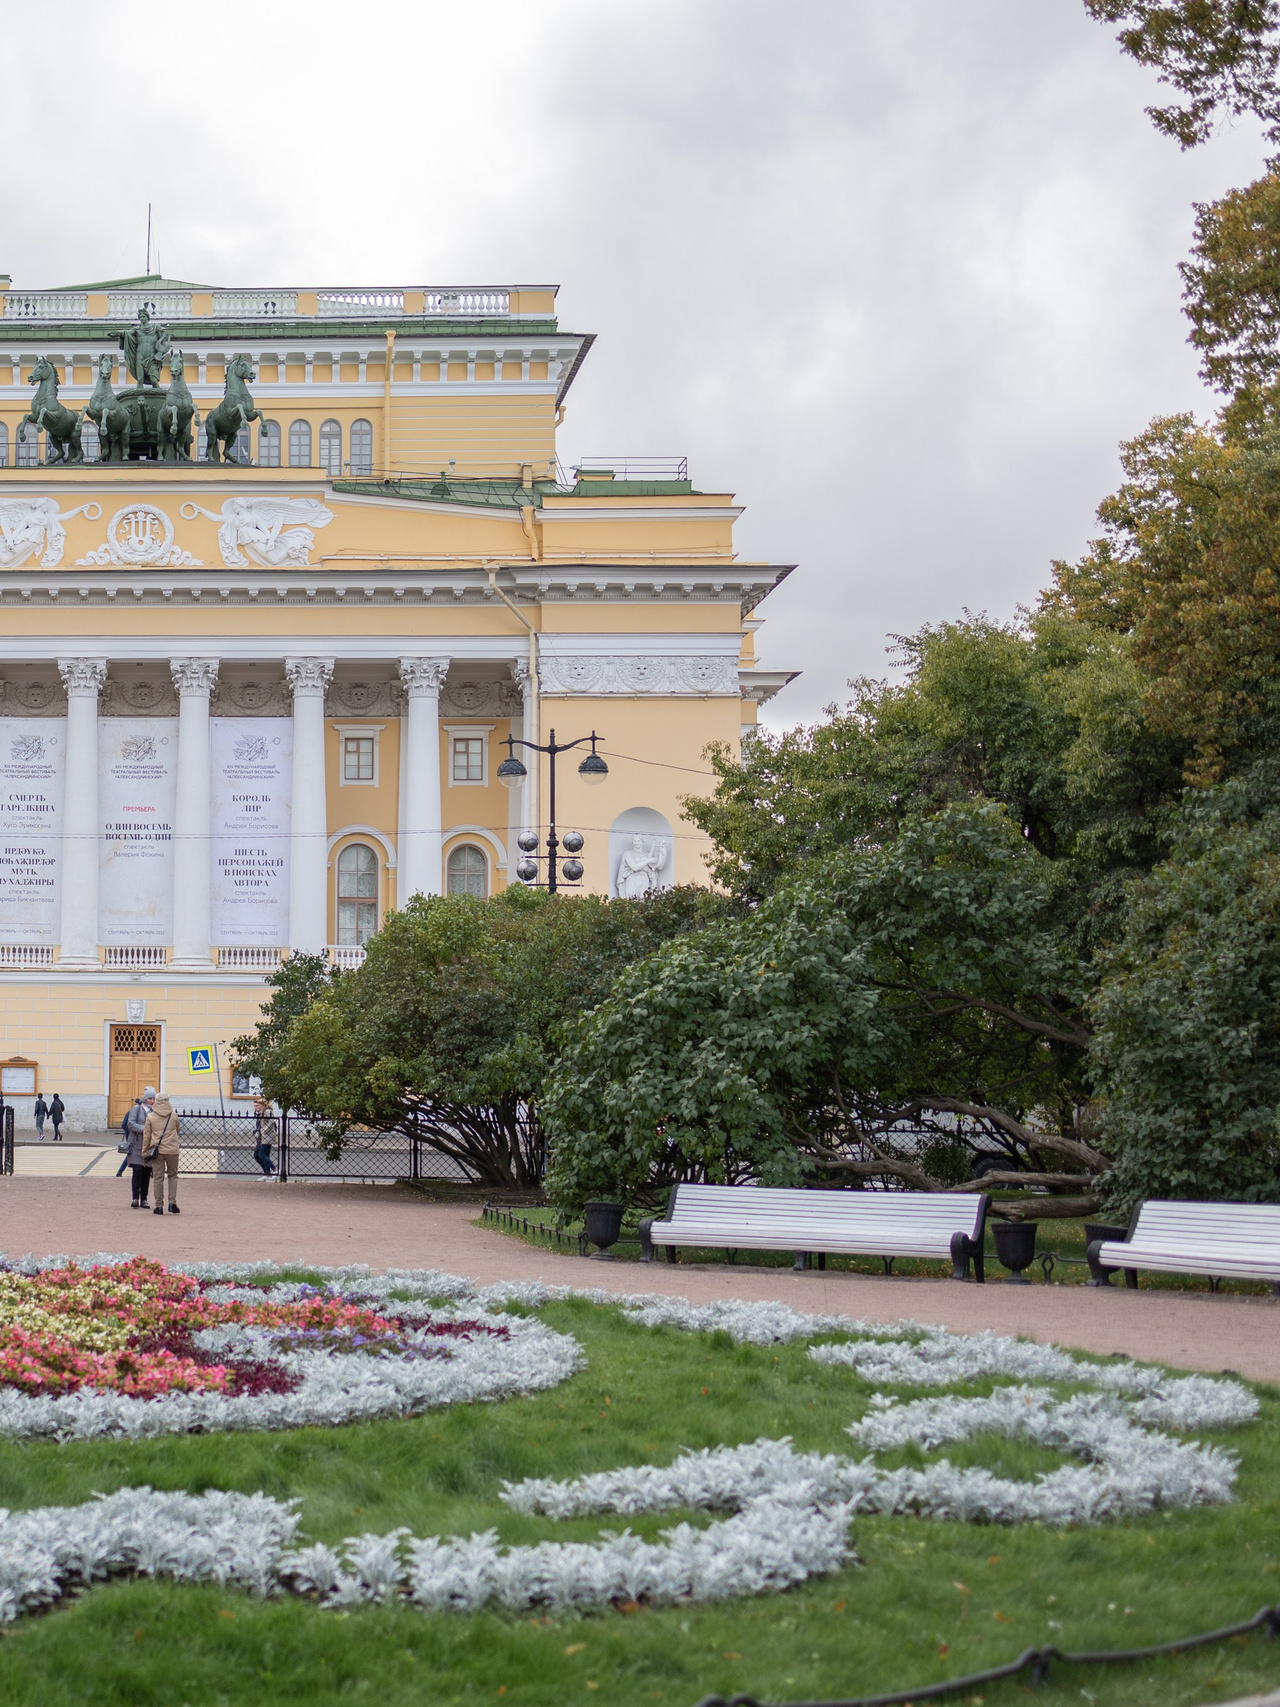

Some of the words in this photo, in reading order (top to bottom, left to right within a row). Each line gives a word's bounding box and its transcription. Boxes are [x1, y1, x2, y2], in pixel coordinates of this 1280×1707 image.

[106, 823, 132, 831] ОДИН
[218, 858, 284, 866] ПЕРСОНАЖЕЙ
[232, 869, 277, 877] ПОИСКАХ
